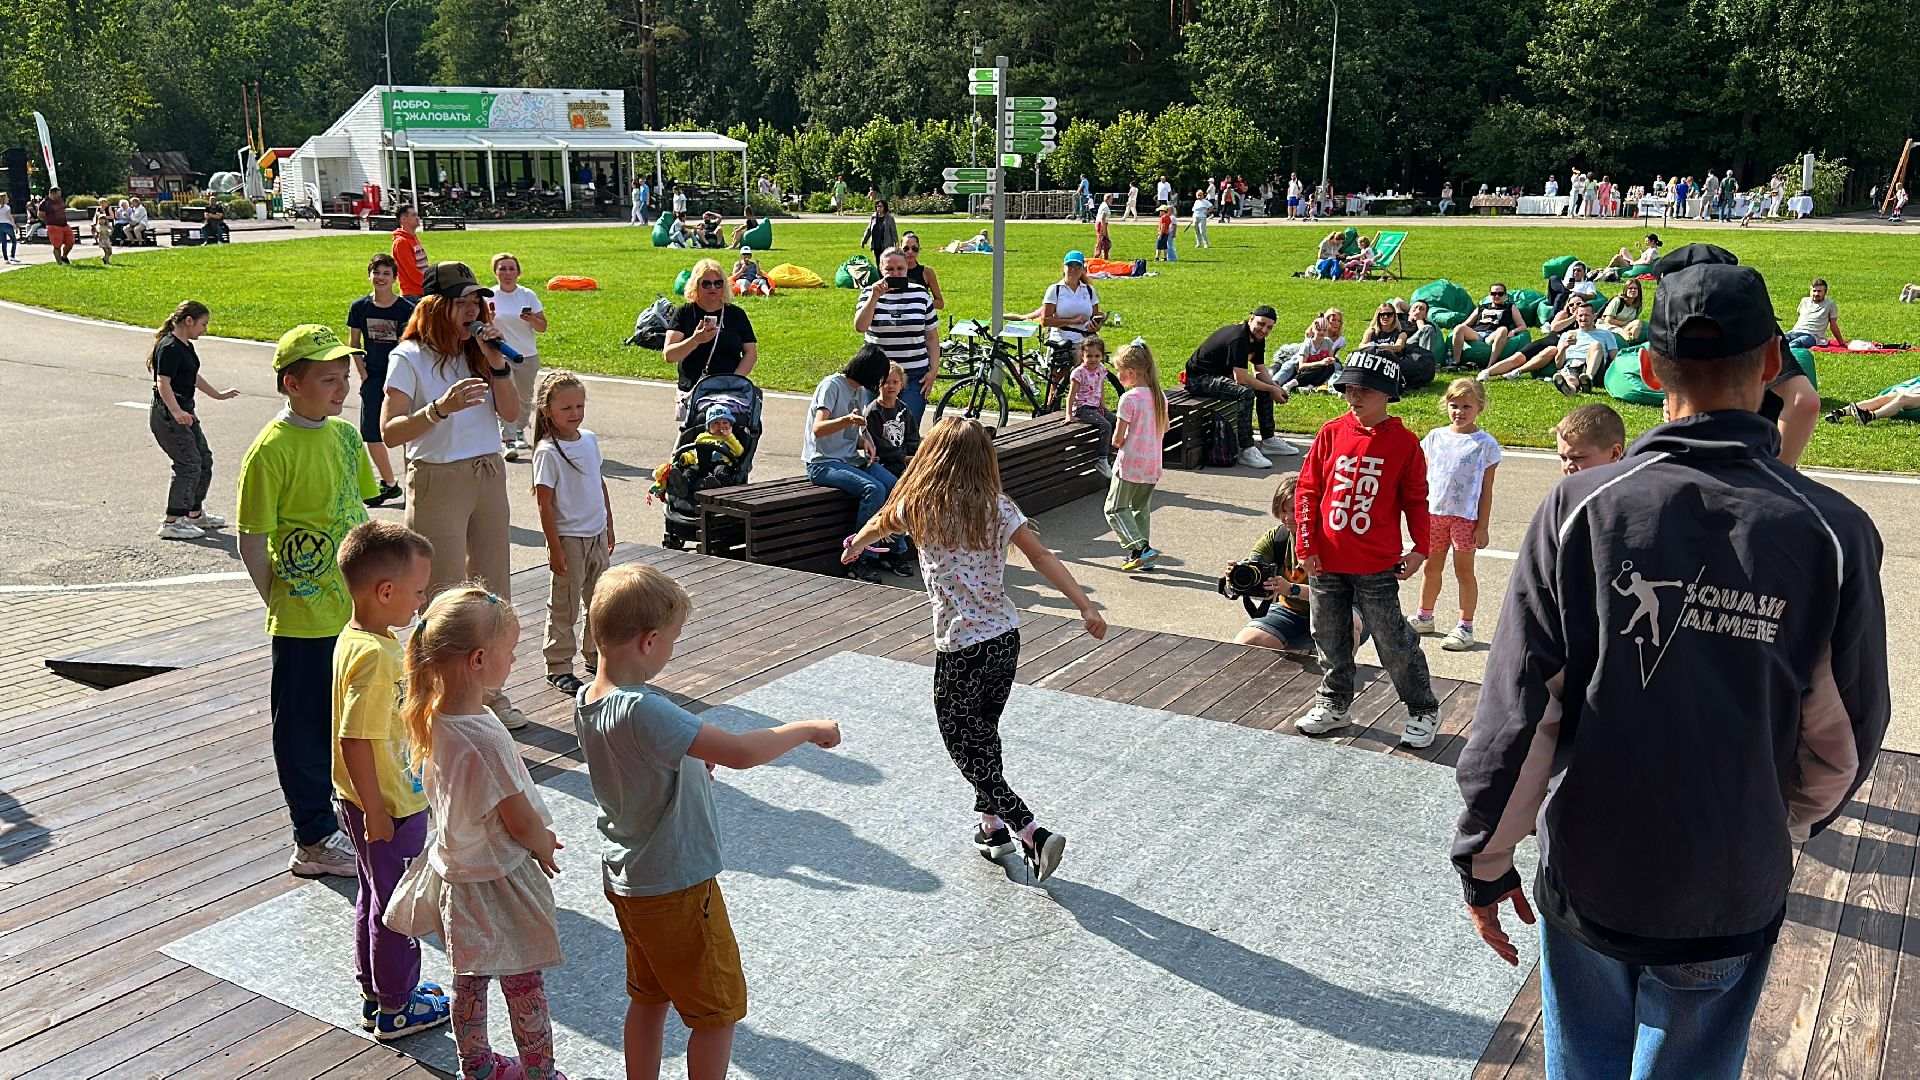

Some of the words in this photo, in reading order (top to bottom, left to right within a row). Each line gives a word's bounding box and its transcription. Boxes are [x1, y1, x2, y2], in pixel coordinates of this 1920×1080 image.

[393, 100, 431, 110] ДОБРО
[393, 112, 471, 121] ОЖАЛОВАТЬ!
[1328, 454, 1358, 531] GLVR
[1350, 455, 1385, 535] HERO
[1683, 583, 1787, 619] SQUASH
[1681, 608, 1779, 643] ALMERE
